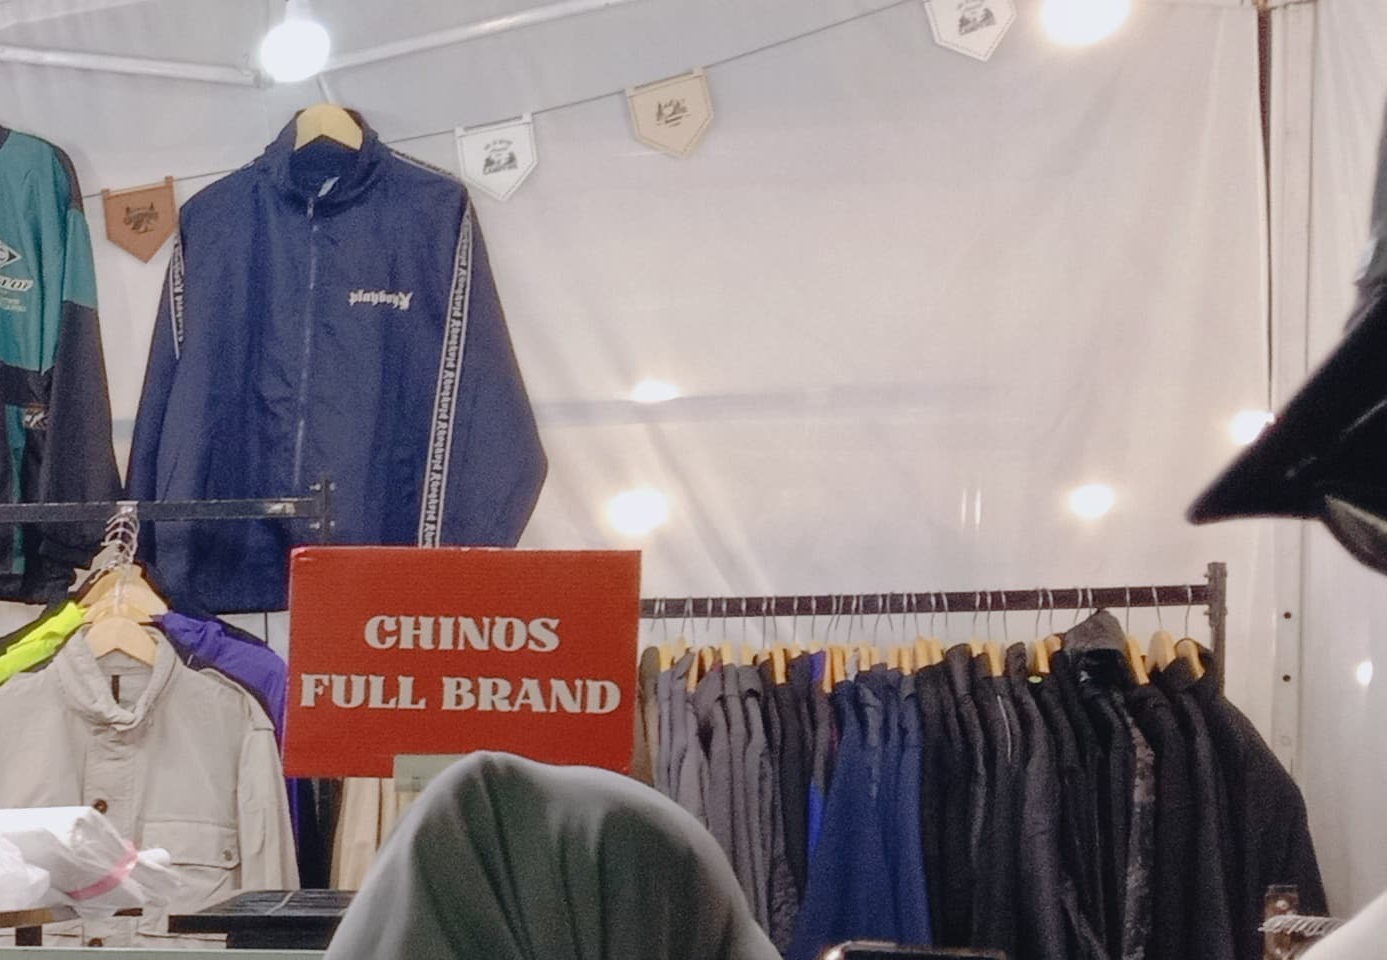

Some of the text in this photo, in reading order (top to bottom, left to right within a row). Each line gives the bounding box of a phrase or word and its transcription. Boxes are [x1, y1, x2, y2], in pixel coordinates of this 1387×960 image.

[364, 615, 560, 652] CHINOS
[299, 673, 621, 714] FULL BRAND
